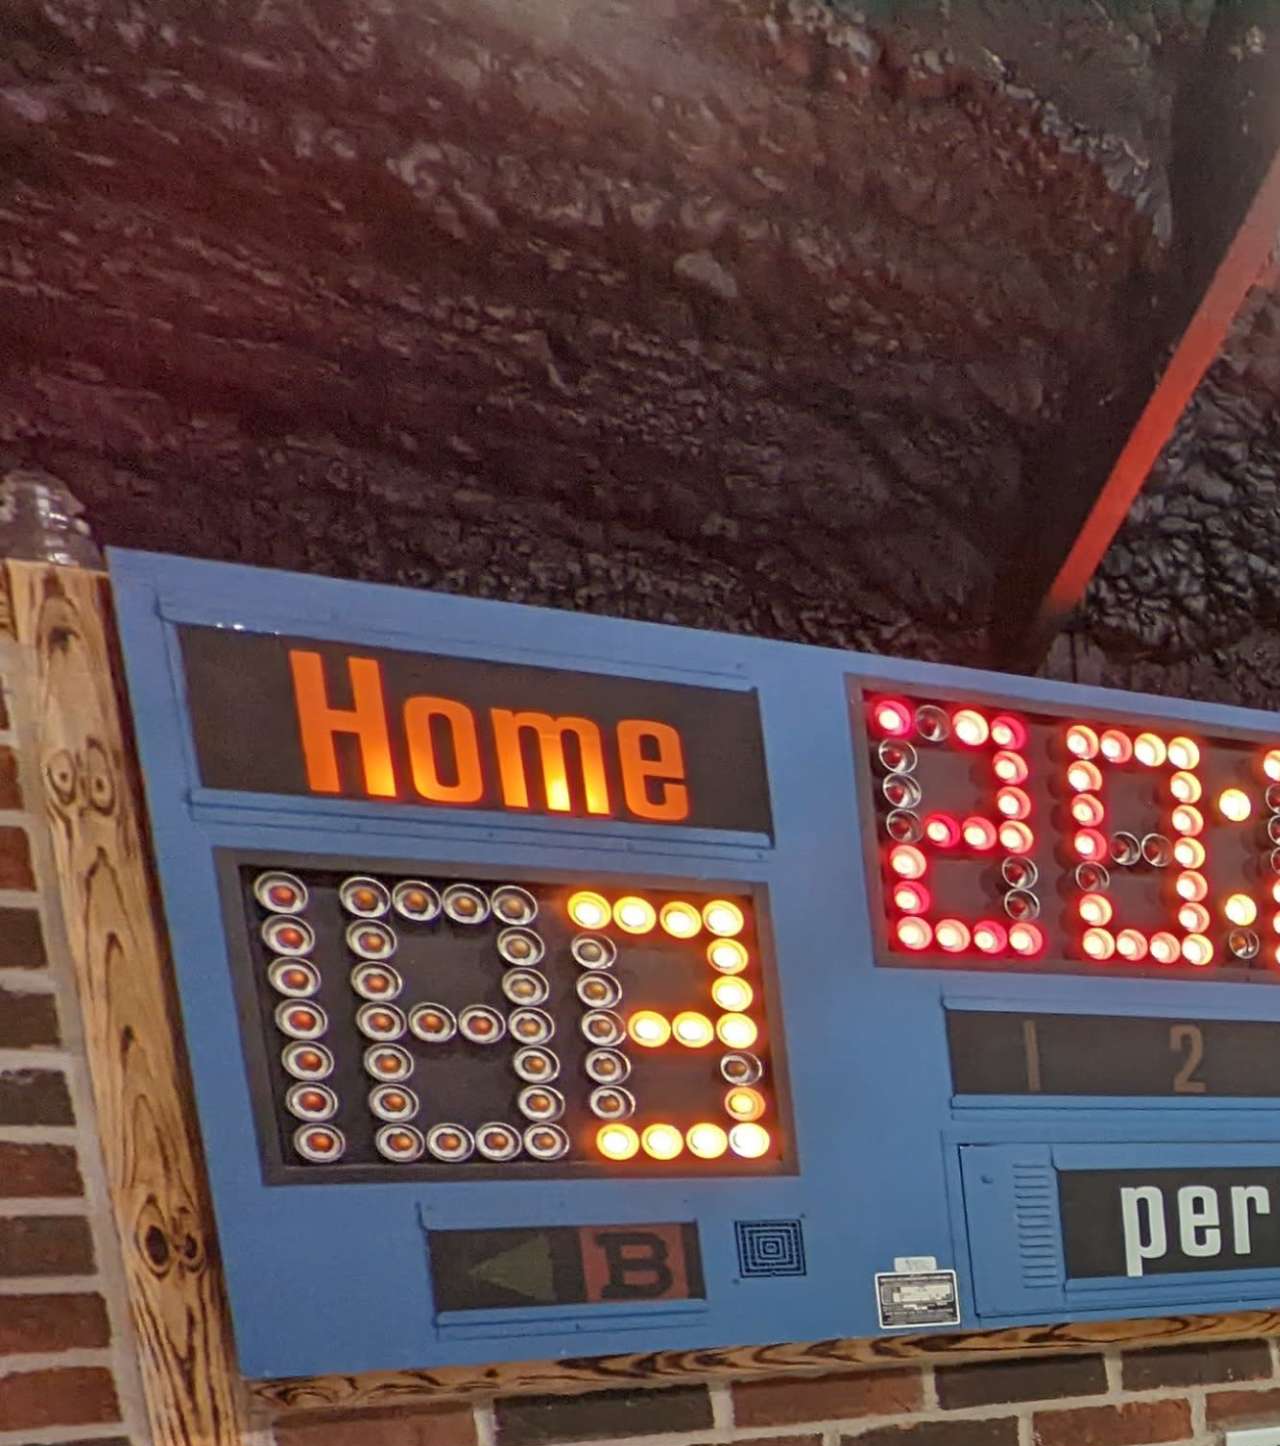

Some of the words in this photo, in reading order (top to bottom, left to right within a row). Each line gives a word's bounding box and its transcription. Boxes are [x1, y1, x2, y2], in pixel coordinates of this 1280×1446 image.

[288, 649, 690, 822] Home
[1169, 1023, 1206, 1094] 2
[595, 1232, 673, 1298] B
